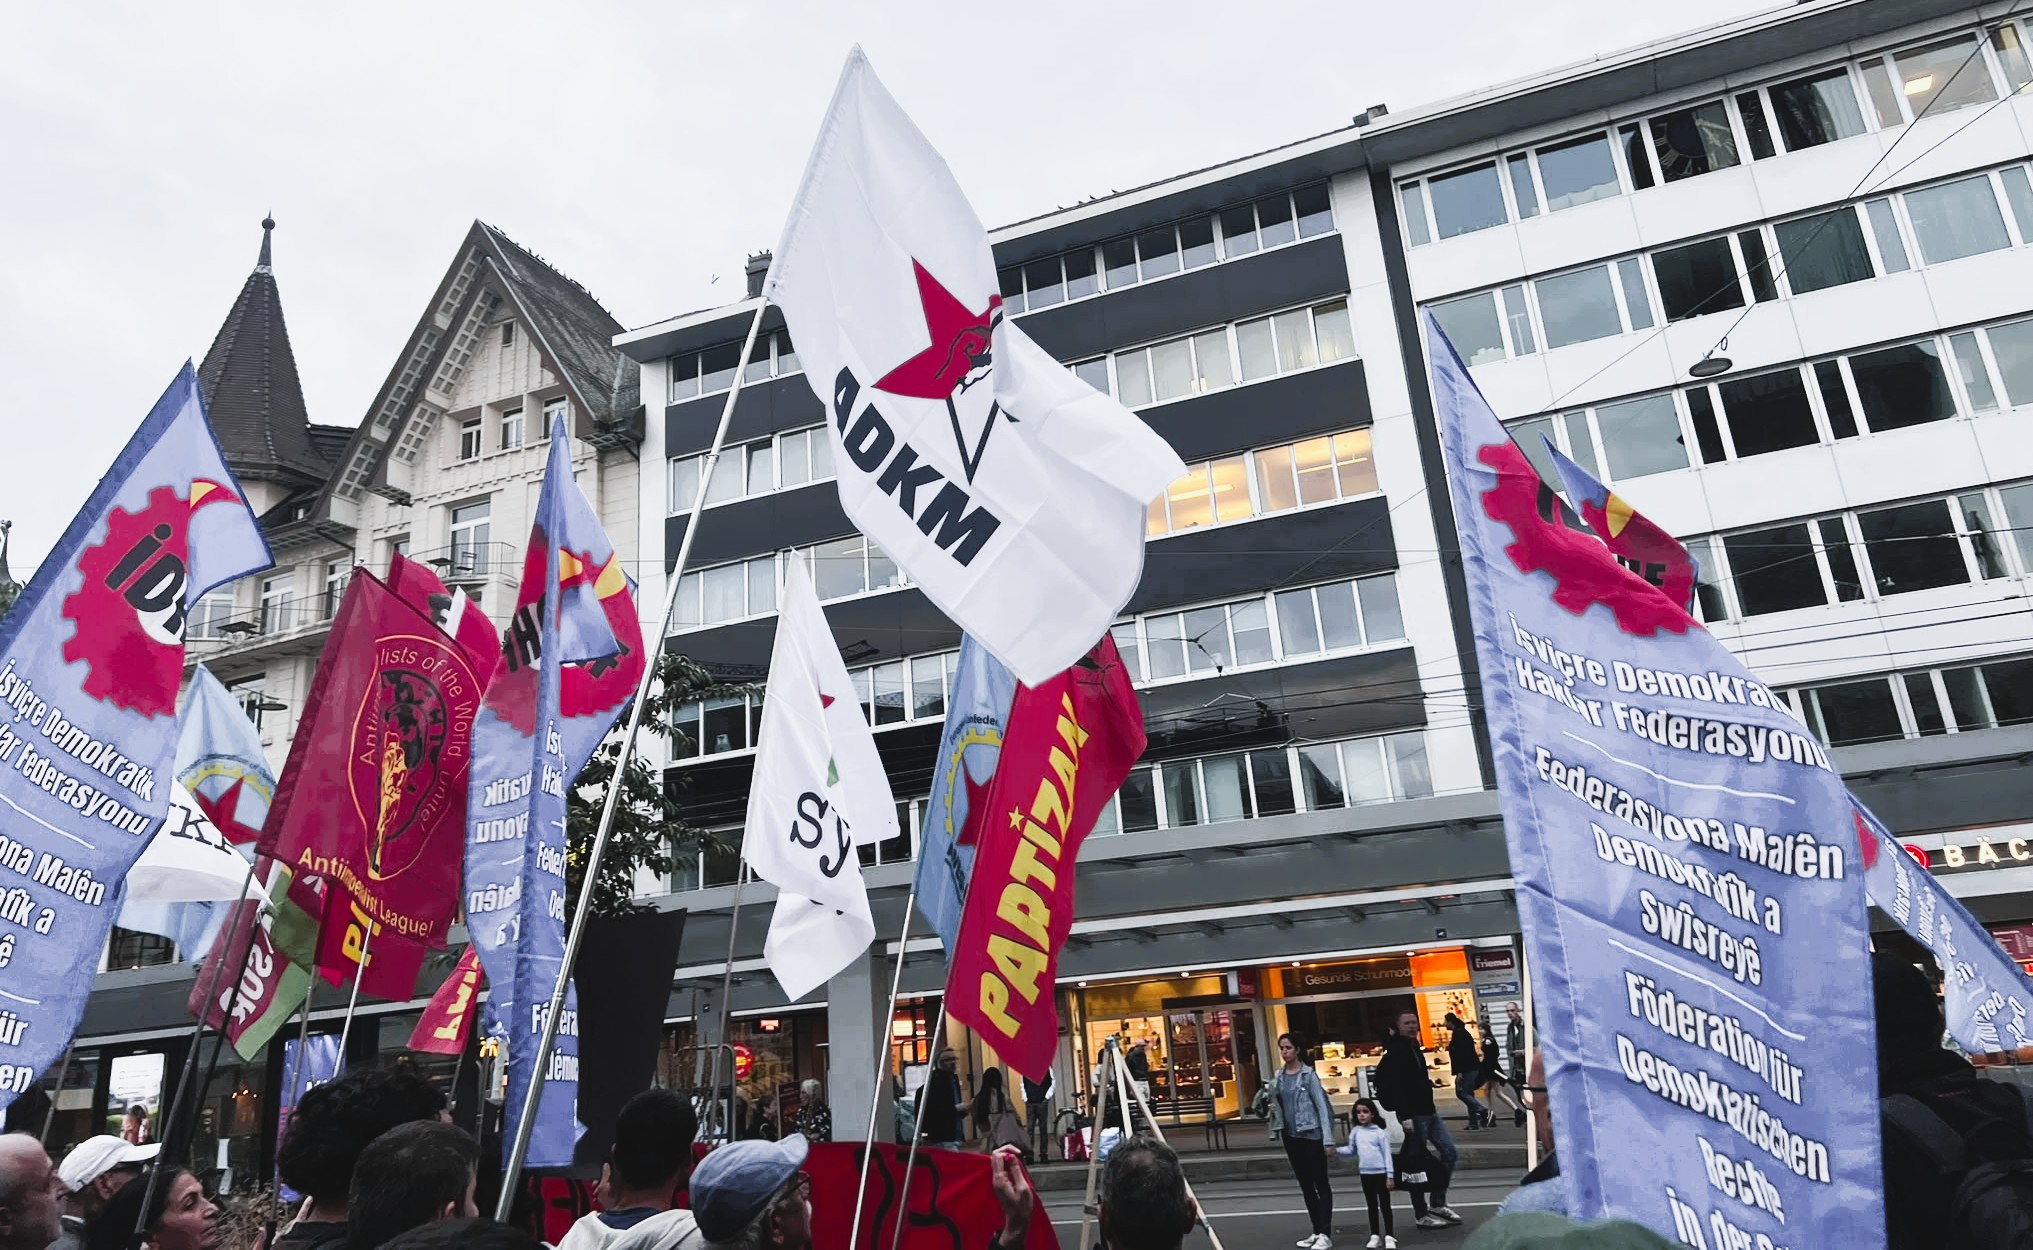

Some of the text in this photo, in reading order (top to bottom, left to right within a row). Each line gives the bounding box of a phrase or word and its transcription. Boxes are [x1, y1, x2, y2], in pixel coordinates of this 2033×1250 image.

[834, 366, 1001, 567] ADKM
[422, 656, 447, 673] of
[439, 668, 463, 698] the
[1507, 610, 1606, 687] İsviçre
[41, 706, 155, 802] Demokratik
[1610, 700, 1833, 773] Federasyonu
[14, 742, 151, 836] Federasyonu
[1535, 746, 1845, 880] Federasyona Mafên
[33, 853, 105, 906] Mafên
[35, 907, 55, 935] a
[380, 899, 434, 938] League!
[1764, 900, 1781, 935] a
[1304, 972, 1351, 986] Gesunde
[1666, 1186, 1708, 1250] in
